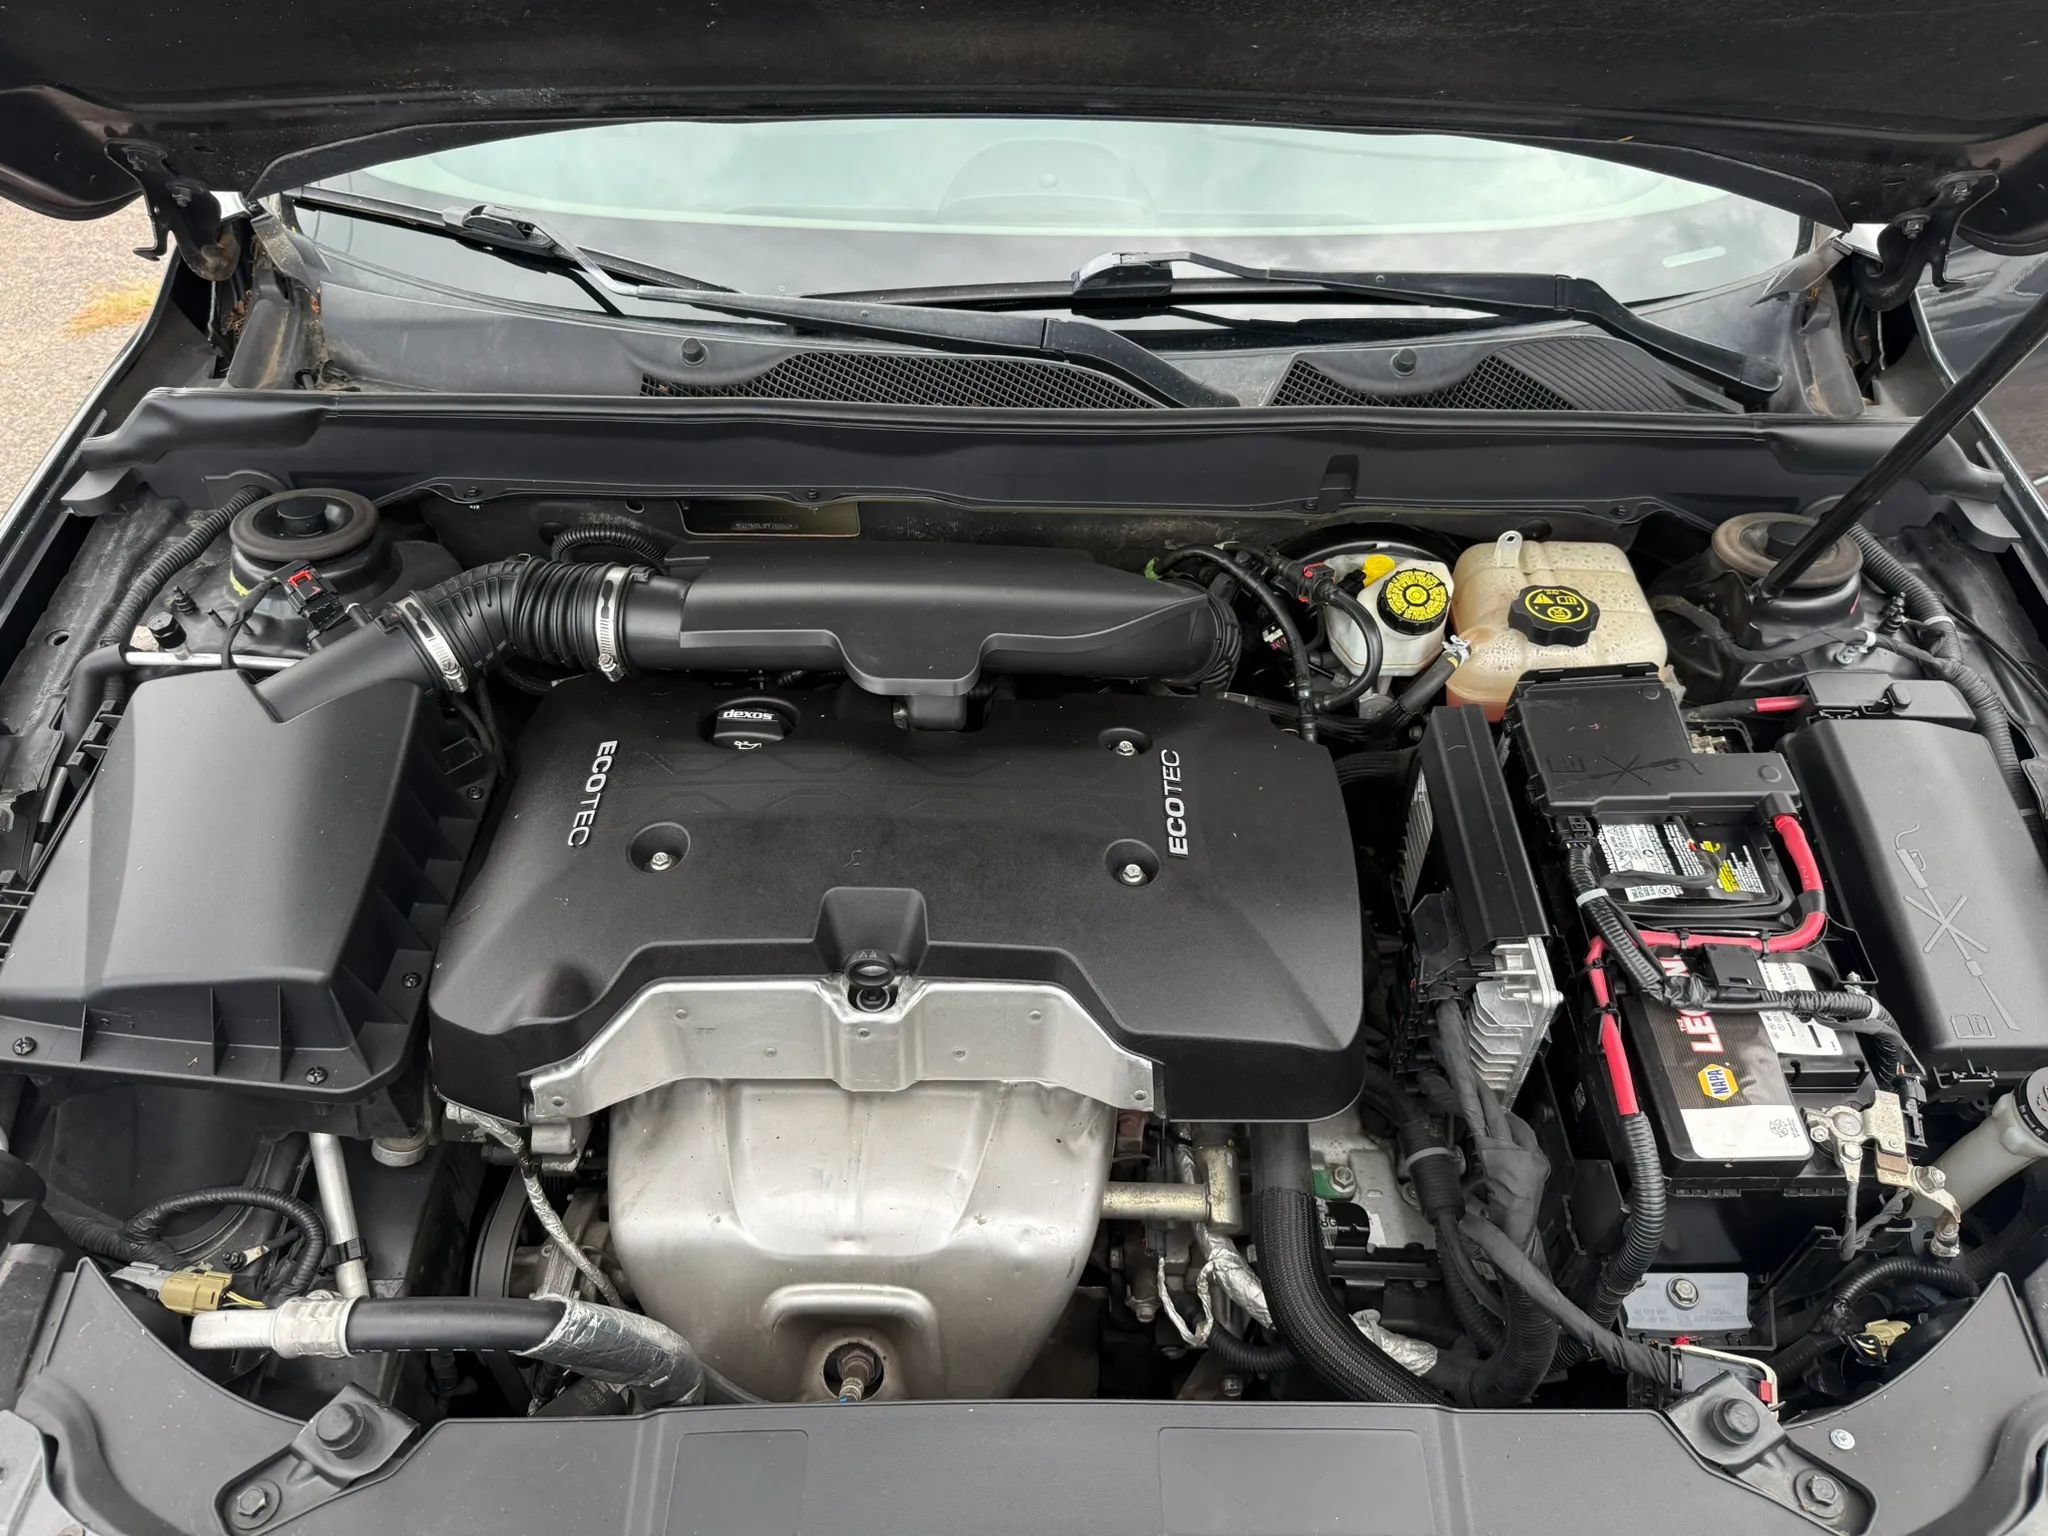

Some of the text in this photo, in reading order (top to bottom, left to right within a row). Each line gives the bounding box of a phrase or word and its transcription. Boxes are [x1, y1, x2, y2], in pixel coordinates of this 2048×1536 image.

[723, 709, 775, 720] dexos
[567, 740, 618, 847] ECOTEC
[1160, 749, 1189, 856] ECOTEC
[1706, 1069, 1730, 1095] NAPA
